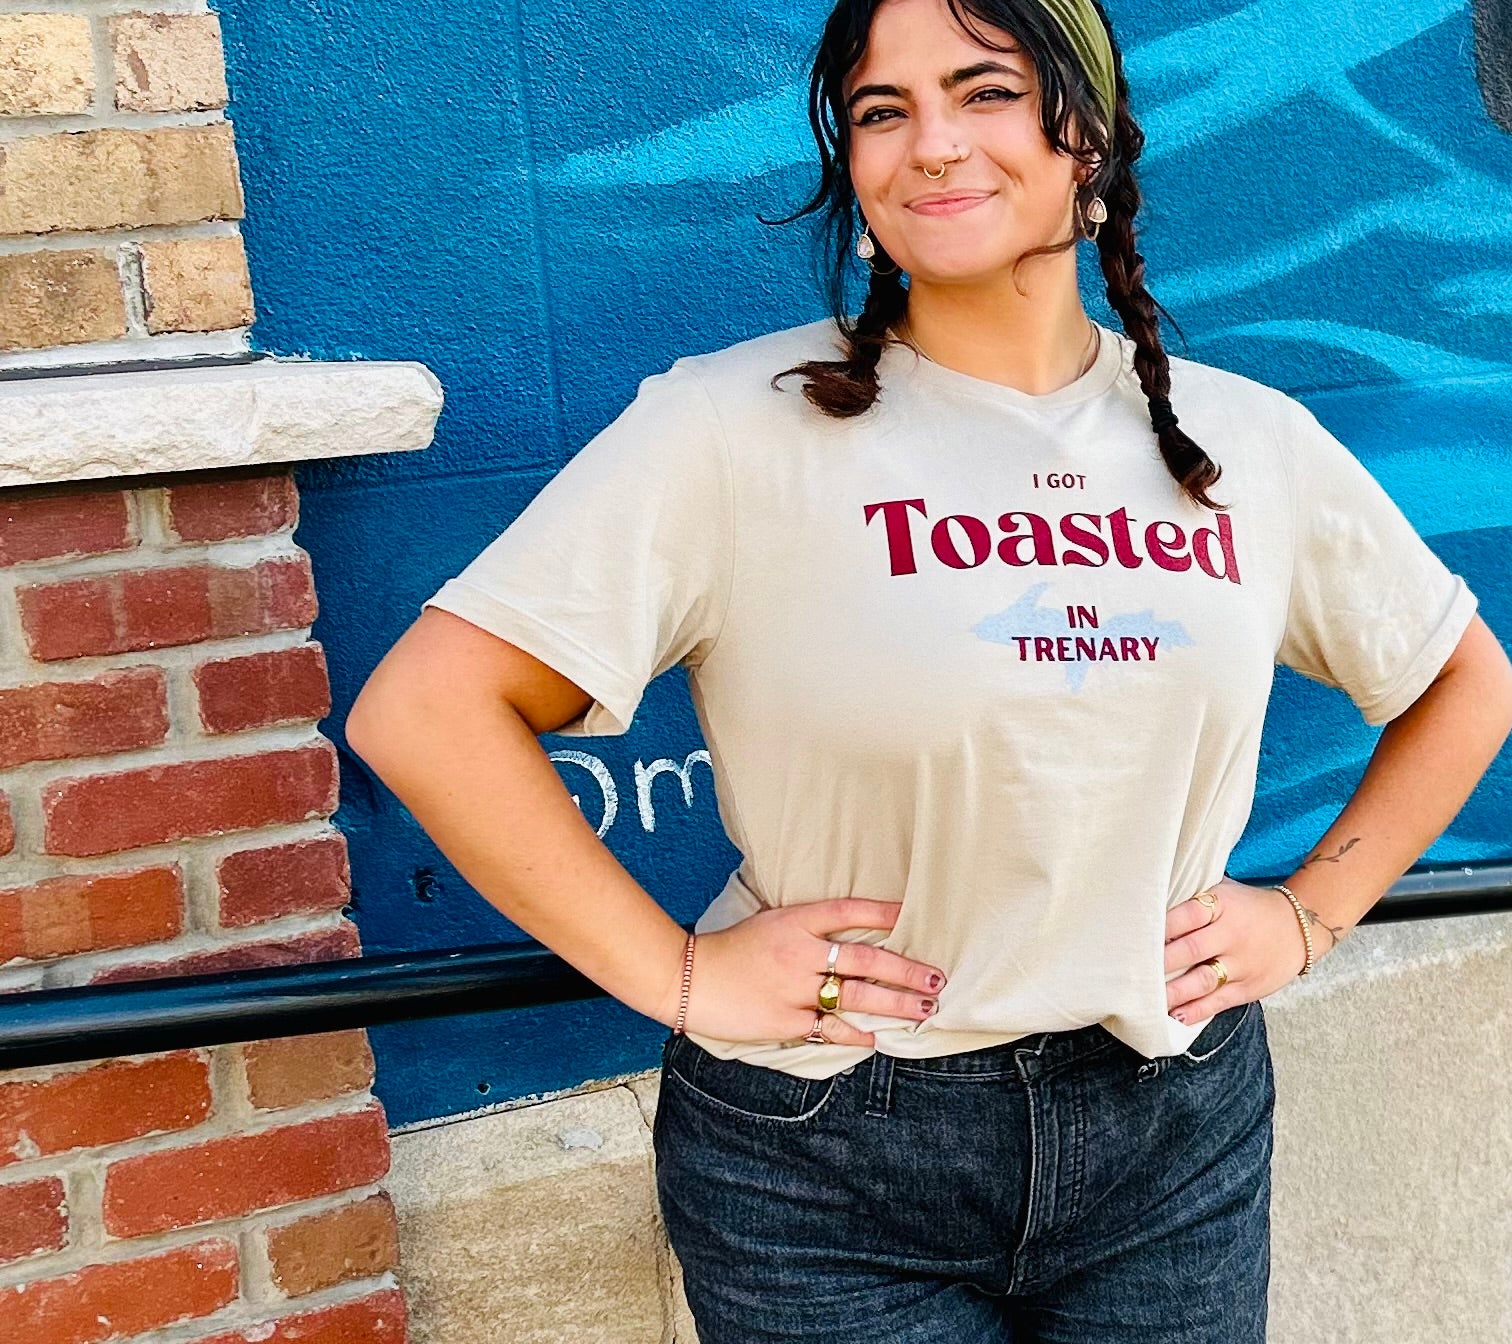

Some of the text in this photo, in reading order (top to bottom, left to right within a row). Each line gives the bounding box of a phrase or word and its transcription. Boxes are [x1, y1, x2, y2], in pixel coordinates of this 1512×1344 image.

[1032, 472, 1087, 491] I GOT
[863, 498, 1242, 586] Toasted
[1066, 605, 1099, 629] IN
[1011, 635, 1160, 662] TRENARY
